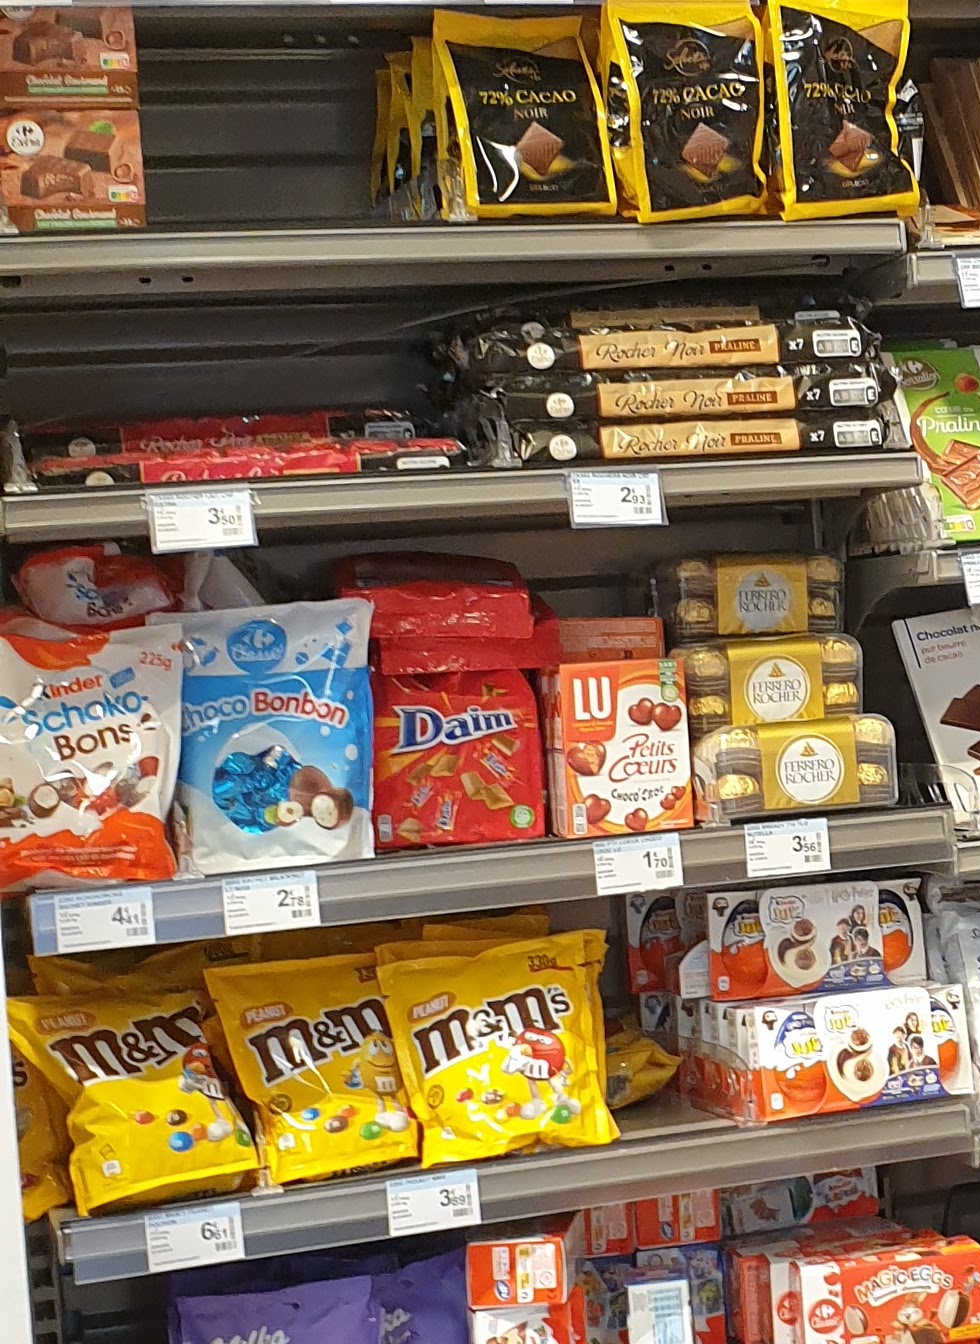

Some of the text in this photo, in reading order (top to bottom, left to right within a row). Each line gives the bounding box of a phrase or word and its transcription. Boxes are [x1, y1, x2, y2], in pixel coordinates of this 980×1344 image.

[478, 88, 577, 106] 72% CACAO
[683, 81, 747, 104] CACAO
[513, 107, 549, 120] NOIR
[679, 106, 715, 121] NOIR
[597, 336, 757, 363] Rocher Noir PRALINE
[788, 338, 804, 352] x7
[616, 389, 773, 414] Rocher Noir PRALINE
[805, 388, 821, 402] x7
[618, 431, 777, 456] Rocher Noir PRALINE
[809, 429, 825, 443] x7
[738, 588, 787, 602] FERRERO
[739, 601, 788, 614] ROCHER
[917, 627, 968, 642] Chocolat
[140, 651, 172, 671] 225g
[752, 678, 801, 692] FERRERO
[572, 676, 613, 721] LU
[752, 690, 802, 705] ROCHER
[254, 691, 346, 727] Bonbon
[400, 707, 513, 748] Daim
[53, 722, 135, 762] Bons
[622, 733, 677, 759] Petits
[784, 757, 835, 773] FERRERO
[785, 770, 836, 785] ROCHER
[243, 1002, 289, 1027] PEANUT
[411, 995, 455, 1021] PEANUT
[40, 1013, 90, 1032] PEANUT
[855, 1265, 953, 1302] MAGIC EGGS
